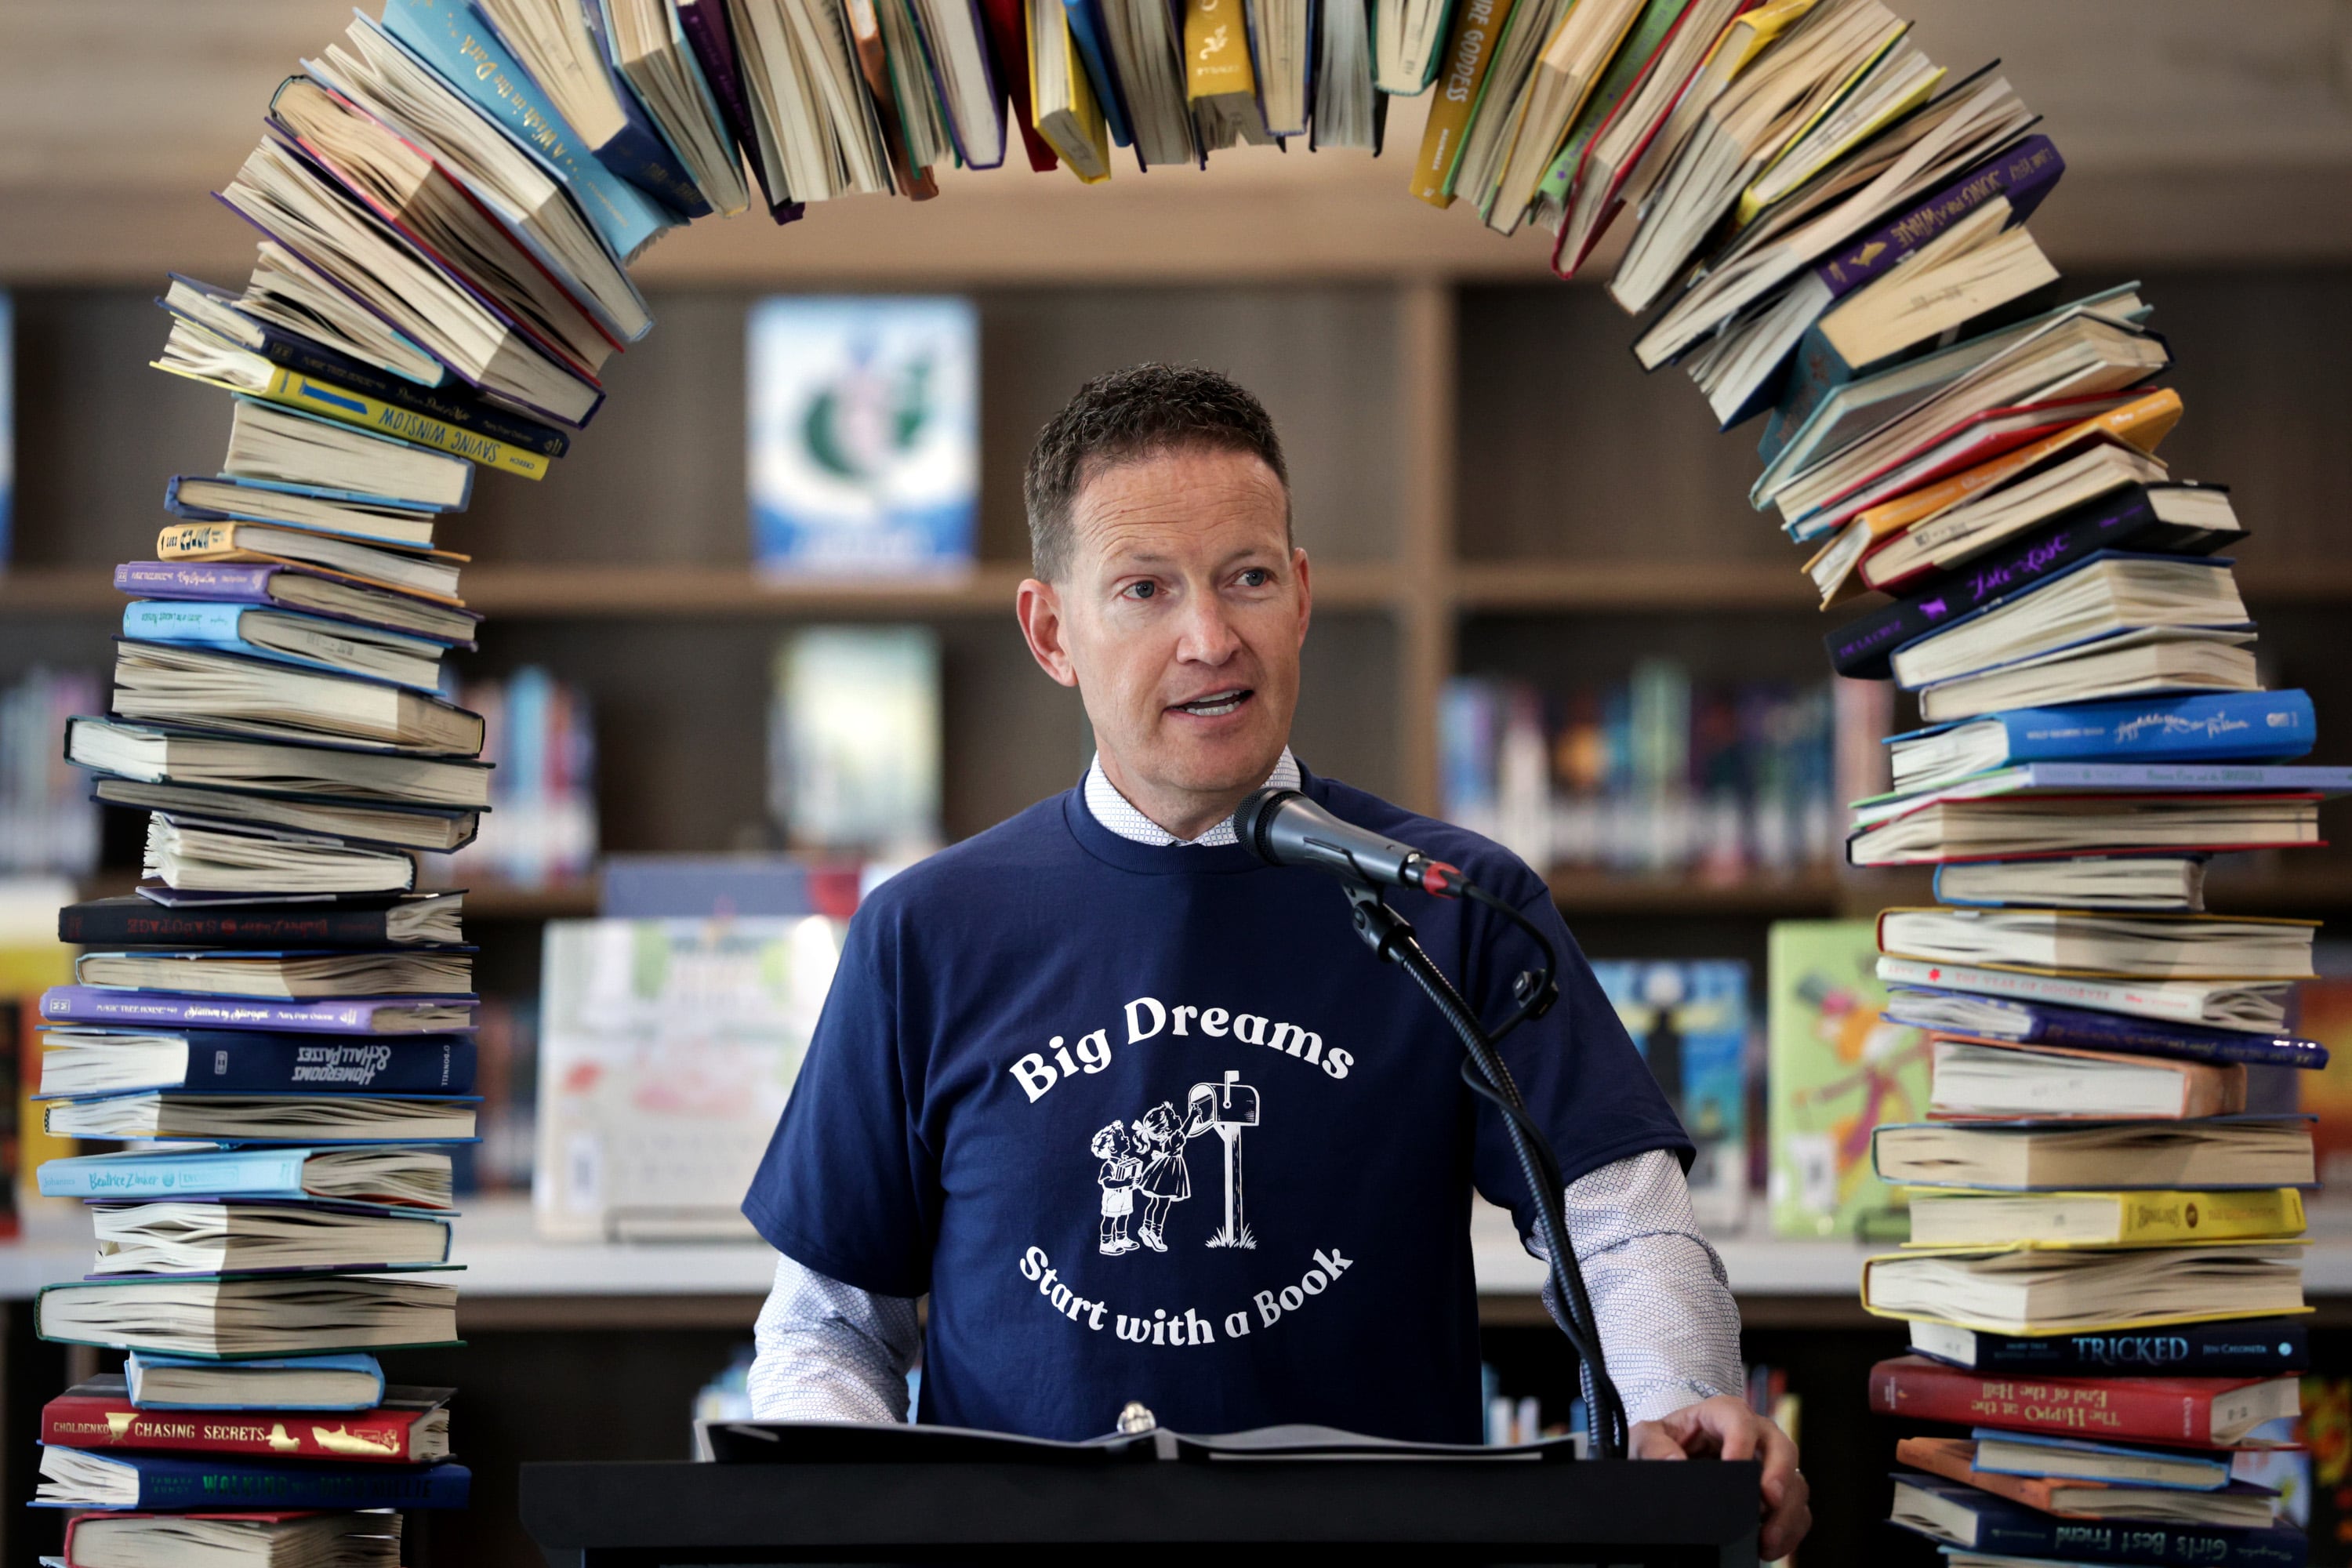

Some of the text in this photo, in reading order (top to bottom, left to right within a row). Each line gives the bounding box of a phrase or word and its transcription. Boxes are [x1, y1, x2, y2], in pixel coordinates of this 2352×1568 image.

[1446, 28, 1484, 103] GODDESS
[459, 31, 568, 157] A Wish in the Dark
[1890, 207, 1934, 246] WHALE
[376, 407, 503, 464] SAVING WINSLOW
[509, 455, 535, 470] CREECH
[126, 917, 216, 935] SABOTAGE
[296, 1047, 342, 1064] PASSES
[1009, 997, 1354, 1103] Big Dreams
[290, 1064, 376, 1084] HOMEROOMS
[441, 1045, 451, 1087] O'DONNELL
[88, 1172, 125, 1190] Beatrice
[1020, 1247, 1352, 1345] Start with a Book
[2071, 1335, 2189, 1363] TRICKED
[1980, 1378, 2108, 1407] End of the Hall
[1971, 1397, 1999, 1415] the
[2000, 1399, 2020, 1414] at
[2087, 1410, 2120, 1427] The
[52, 1419, 110, 1436] CHOLDENKO
[134, 1422, 267, 1441] CHASING SECRETS
[201, 1474, 287, 1496] WALKING
[2054, 1524, 2114, 1549] Friend
[2119, 1529, 2167, 1554] Best
[2174, 1534, 2229, 1559] Girl's
